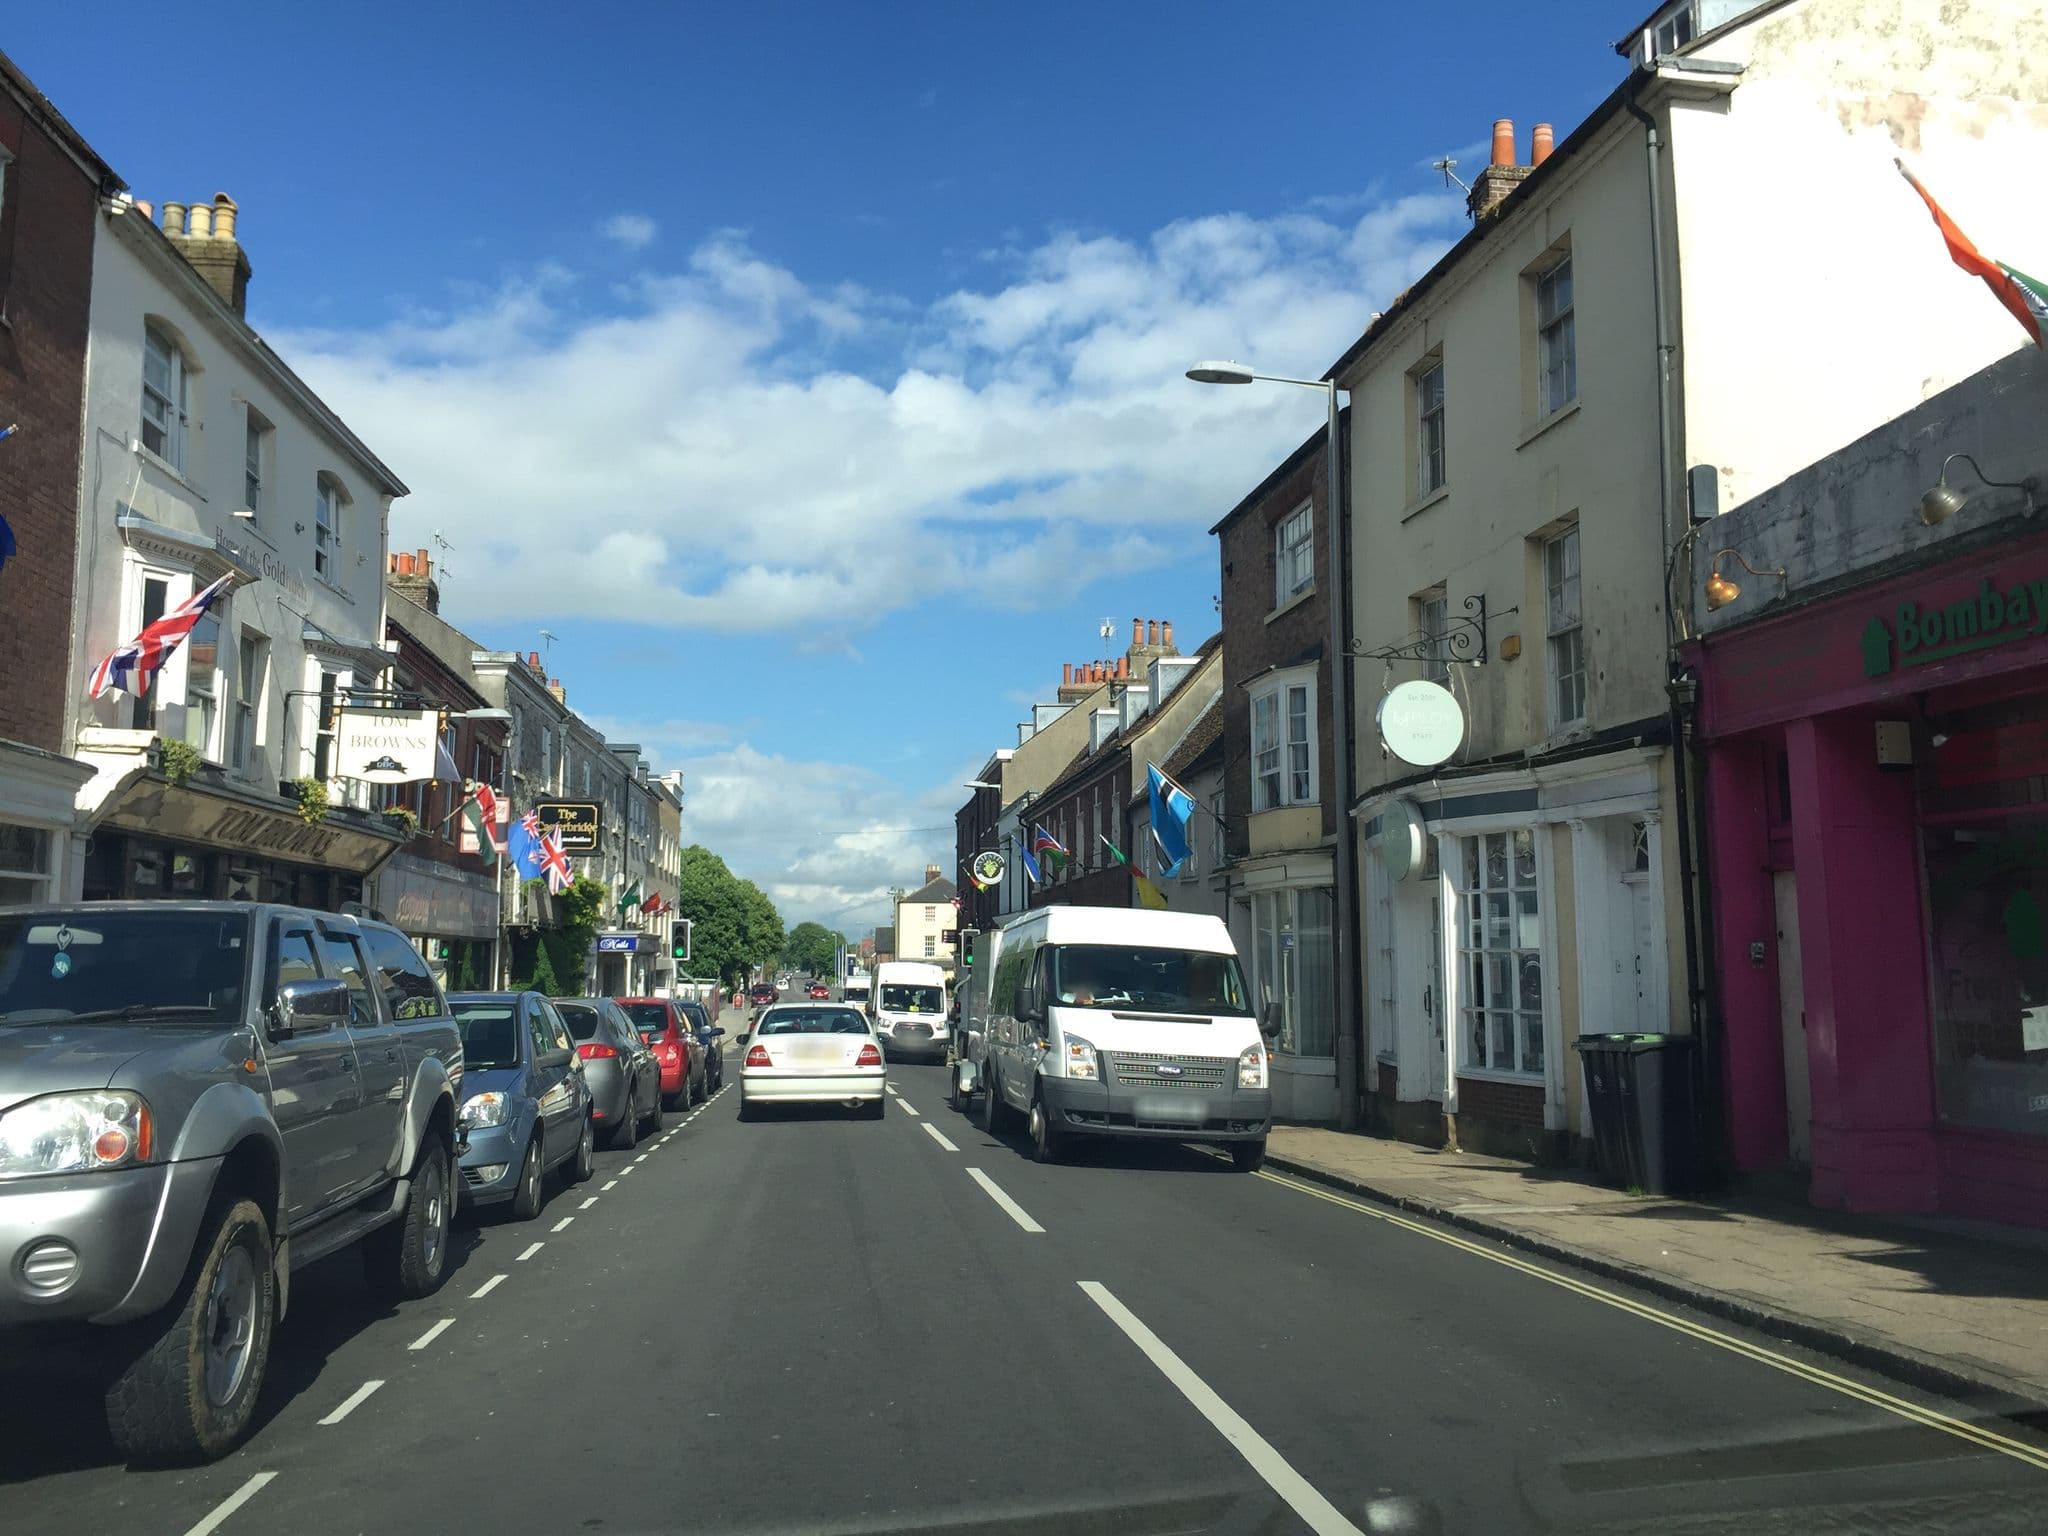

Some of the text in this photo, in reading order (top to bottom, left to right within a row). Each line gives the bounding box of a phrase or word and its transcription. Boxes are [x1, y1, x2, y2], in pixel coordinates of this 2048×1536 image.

[1897, 577, 2048, 653] Bombay
[373, 715, 409, 729] TOM
[350, 734, 427, 750] BROWNS
[557, 808, 578, 822] The
